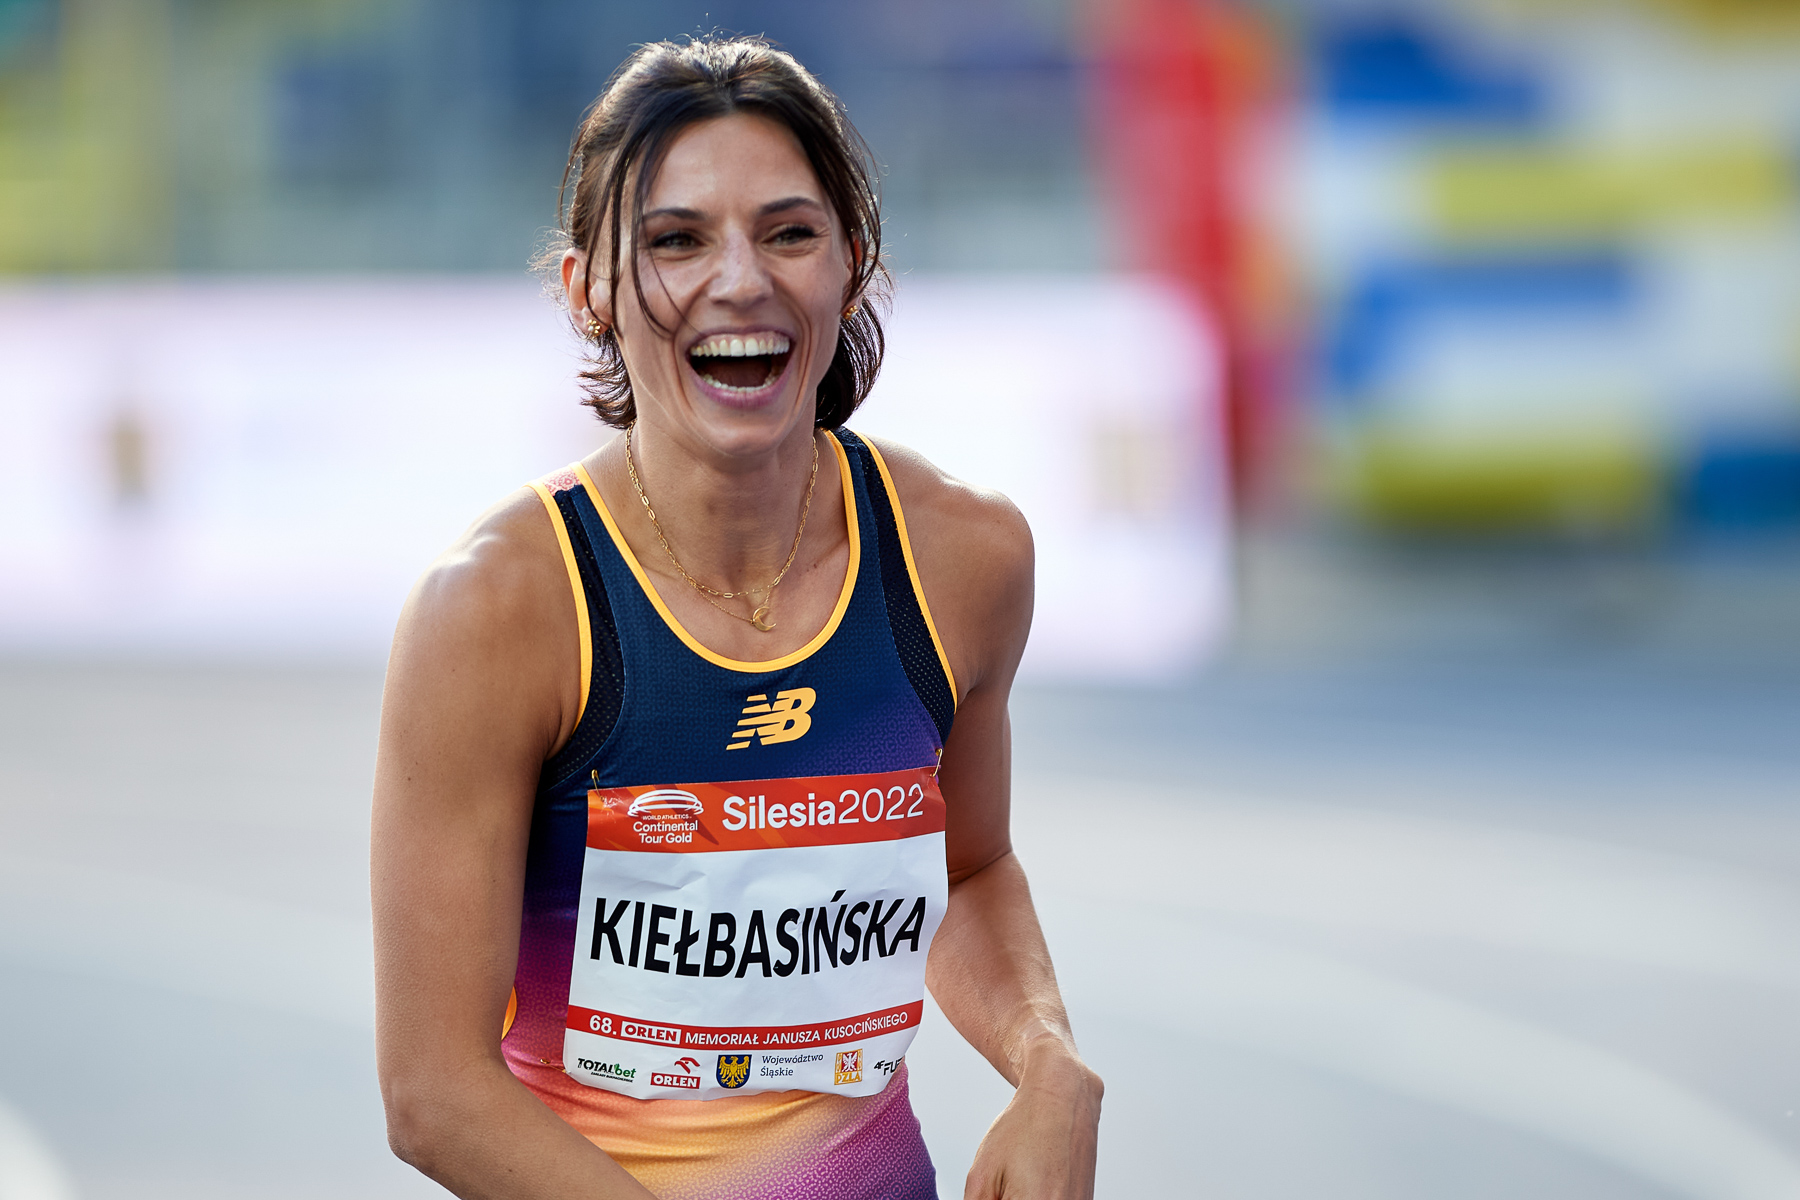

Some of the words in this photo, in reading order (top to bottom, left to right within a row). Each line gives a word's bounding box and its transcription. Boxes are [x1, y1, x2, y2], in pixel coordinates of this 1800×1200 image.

[726, 687, 817, 750] NB
[633, 820, 698, 832] Continental
[639, 833, 663, 843] Tour
[665, 832, 692, 843] Gold
[590, 889, 927, 979] KIEŁBASIŃSKA
[589, 1014, 617, 1035] 68.
[625, 1024, 677, 1042] ORLEN
[685, 1032, 759, 1045] MEMORIAŁ
[763, 1029, 820, 1045] JANUSZA
[824, 1011, 908, 1040] KUSOCIŃSKIEGO
[762, 1054, 824, 1065] Województwo
[760, 1065, 794, 1078] Śląskie
[836, 1071, 861, 1084] PZLA
[653, 1074, 698, 1088] ORLEN
